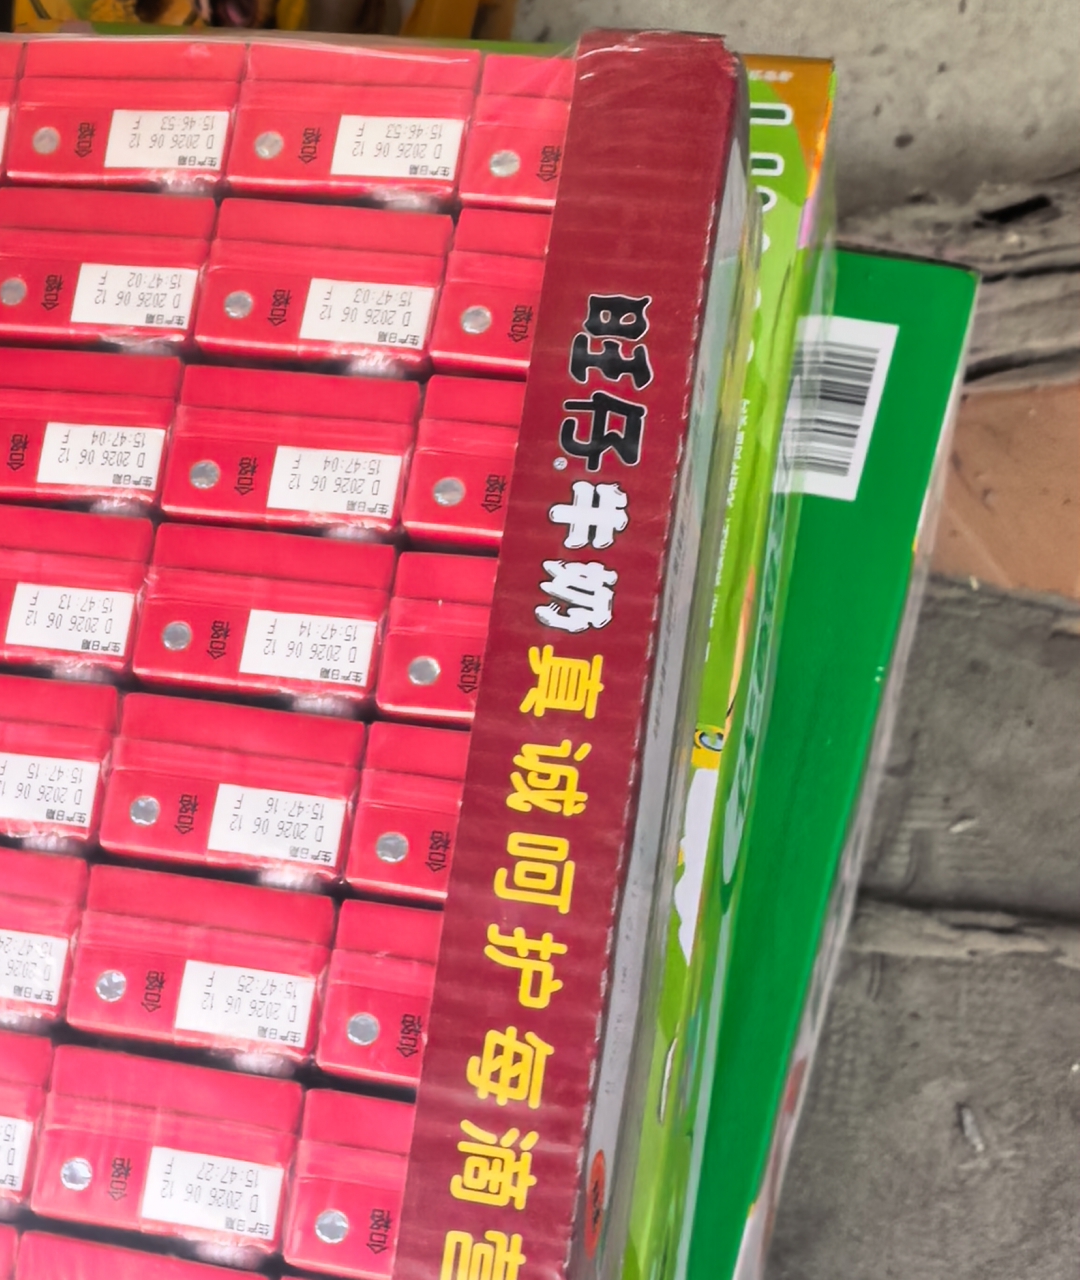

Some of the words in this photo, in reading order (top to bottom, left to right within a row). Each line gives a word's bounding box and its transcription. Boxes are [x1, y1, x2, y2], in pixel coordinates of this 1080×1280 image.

[159, 115, 216, 133] 15:46:53
[384, 123, 444, 141] 15:46:53
[127, 132, 142, 150] 12
[147, 132, 166, 150] 06
[168, 133, 202, 151] 2026
[350, 139, 366, 158] 12
[372, 141, 391, 159] 06
[394, 141, 429, 160] 2026
[177, 155, 218, 168] 生产日期
[408, 164, 451, 178] 生产日期
[126, 271, 183, 291] 15:47:02
[93, 287, 108, 306] 12
[114, 289, 132, 308] 06
[135, 291, 169, 310] 2026
[352, 287, 414, 308] 15:47:03
[144, 312, 186, 327] 生产日期
[318, 303, 333, 322] 12
[340, 305, 359, 324] 06
[362, 307, 398, 327] 2026
[376, 330, 421, 347] 生产日期
[90, 430, 147, 450] 15:47:04
[56, 446, 71, 465] 12
[77, 447, 96, 466] 06
[99, 449, 132, 469] 2026
[322, 455, 383, 477] 15:47:04
[112, 473, 154, 488] 生产日期
[287, 472, 302, 491] 12
[308, 474, 328, 493] 06
[332, 475, 367, 496] 2026
[345, 499, 391, 516] 生产日期
[57, 592, 115, 615] 15:47:13
[24, 608, 39, 627] 12
[45, 611, 64, 631] 06
[67, 614, 101, 635] 2026
[298, 620, 359, 643] 15:47:14
[80, 638, 122, 654] 生产日期
[262, 637, 277, 657] 12
[284, 640, 304, 660] 06
[308, 642, 343, 663] 2026
[319, 666, 364, 684] 生产日期
[25, 762, 84, 785] 15:47:15
[13, 781, 33, 801] 06
[35, 784, 69, 805] 2026
[45, 807, 88, 825] 生产日期
[263, 796, 325, 822] 15:47:16
[228, 812, 243, 832] 12
[251, 815, 271, 836] 06
[274, 819, 310, 842] 2026
[290, 846, 334, 864] 生产日期
